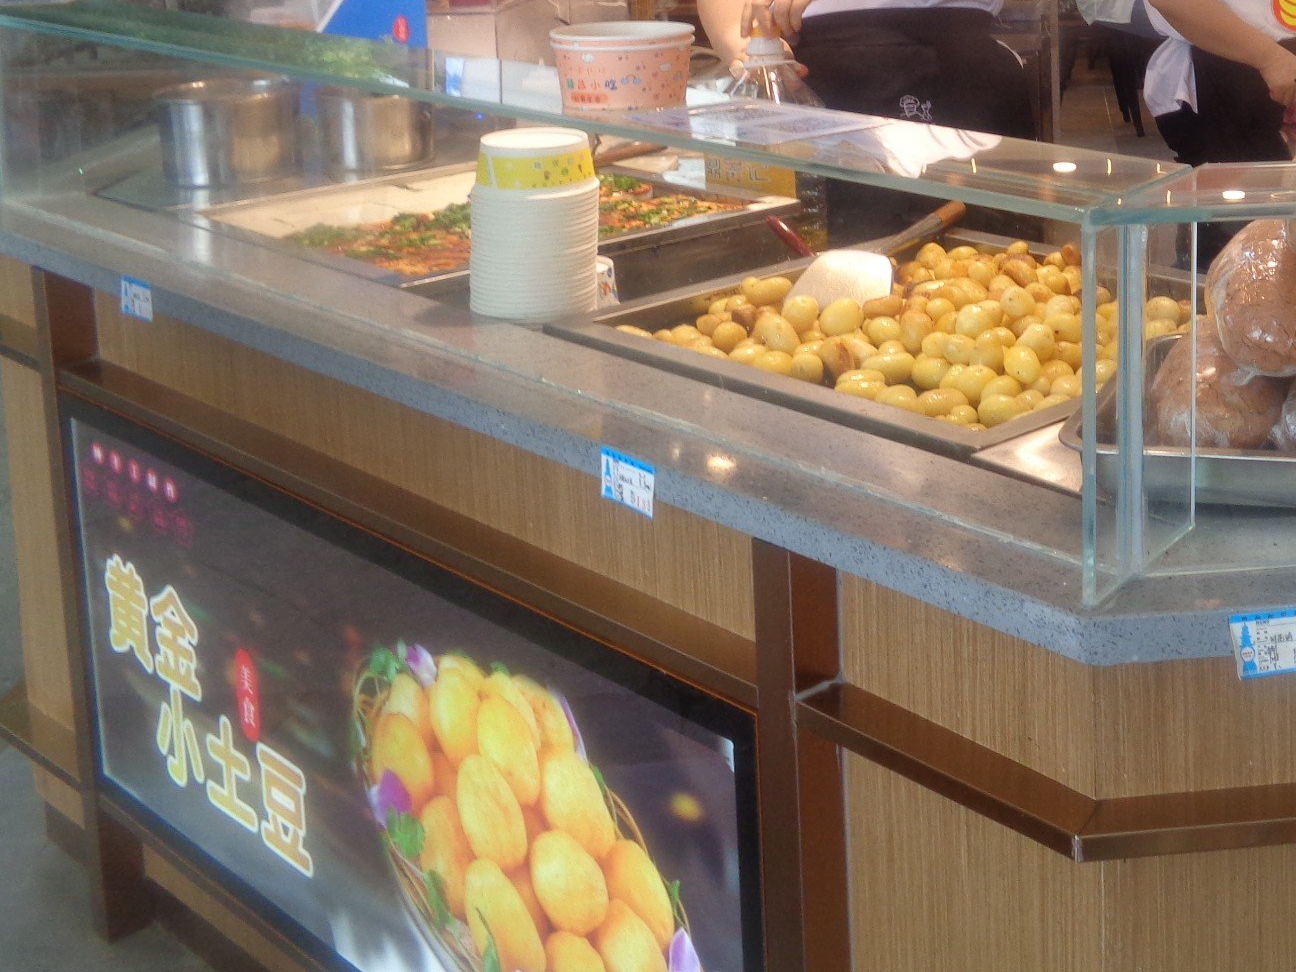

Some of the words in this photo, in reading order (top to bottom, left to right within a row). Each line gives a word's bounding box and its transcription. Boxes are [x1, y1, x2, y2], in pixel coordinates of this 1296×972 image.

[105, 554, 202, 702] 黄金
[157, 683, 314, 878] 小土豆
